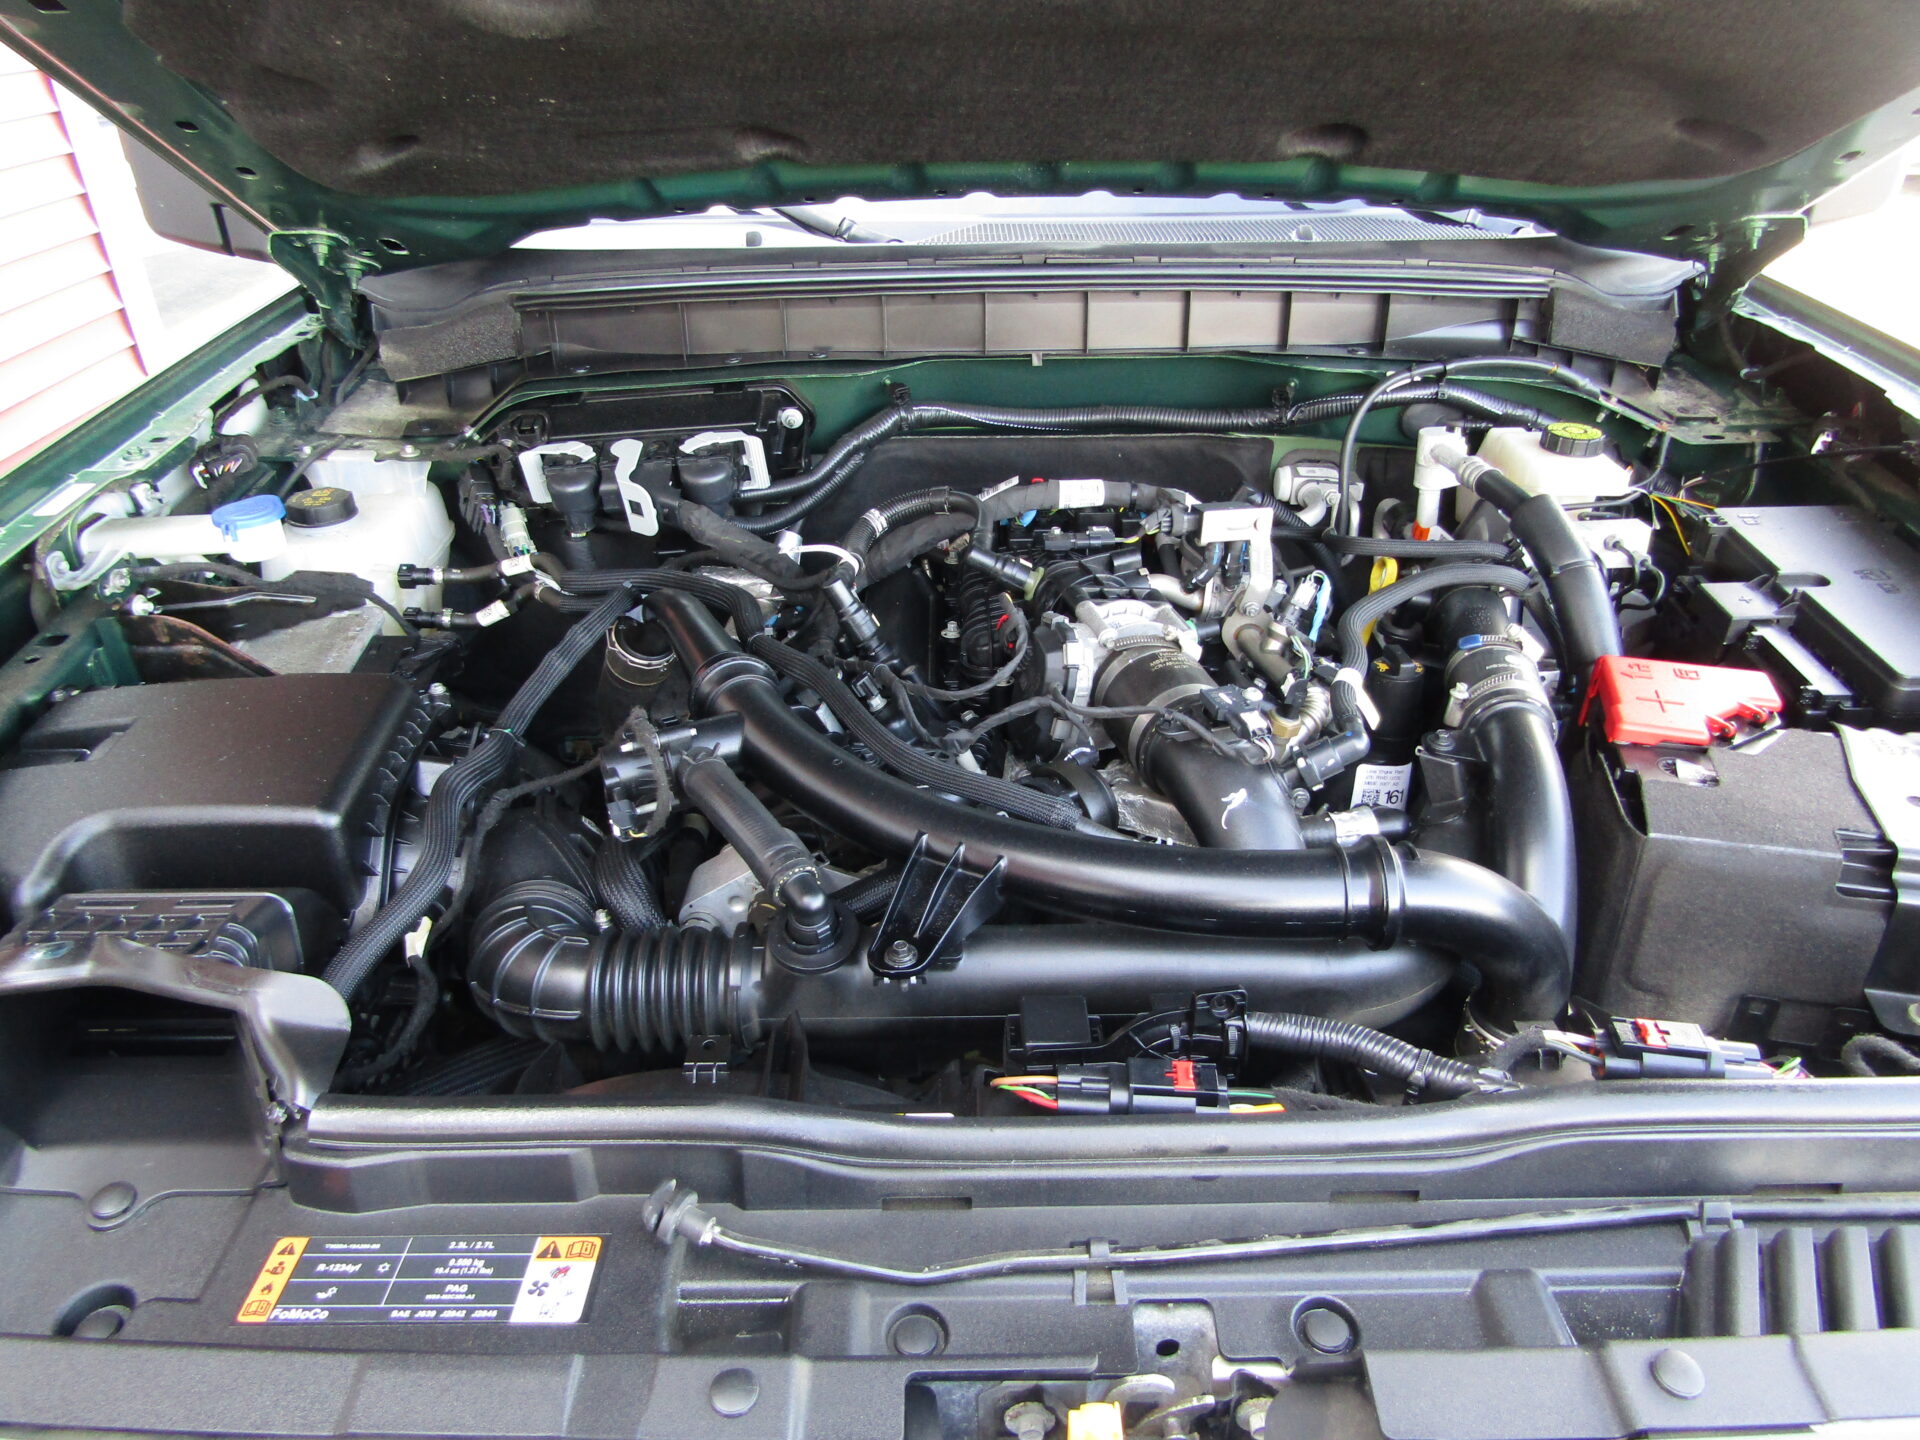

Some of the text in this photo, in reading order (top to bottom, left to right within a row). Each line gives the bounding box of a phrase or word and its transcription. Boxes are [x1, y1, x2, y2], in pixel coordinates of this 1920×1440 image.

[1384, 789, 1404, 804] 161
[448, 1241, 469, 1249] 2.3L
[474, 1241, 495, 1249] 2.7L
[315, 1263, 362, 1273] R-1234yf
[473, 1258, 485, 1268] kg
[445, 1284, 469, 1293] PAG
[269, 1308, 330, 1320] FoMoCo
[390, 1310, 411, 1318] SAE
